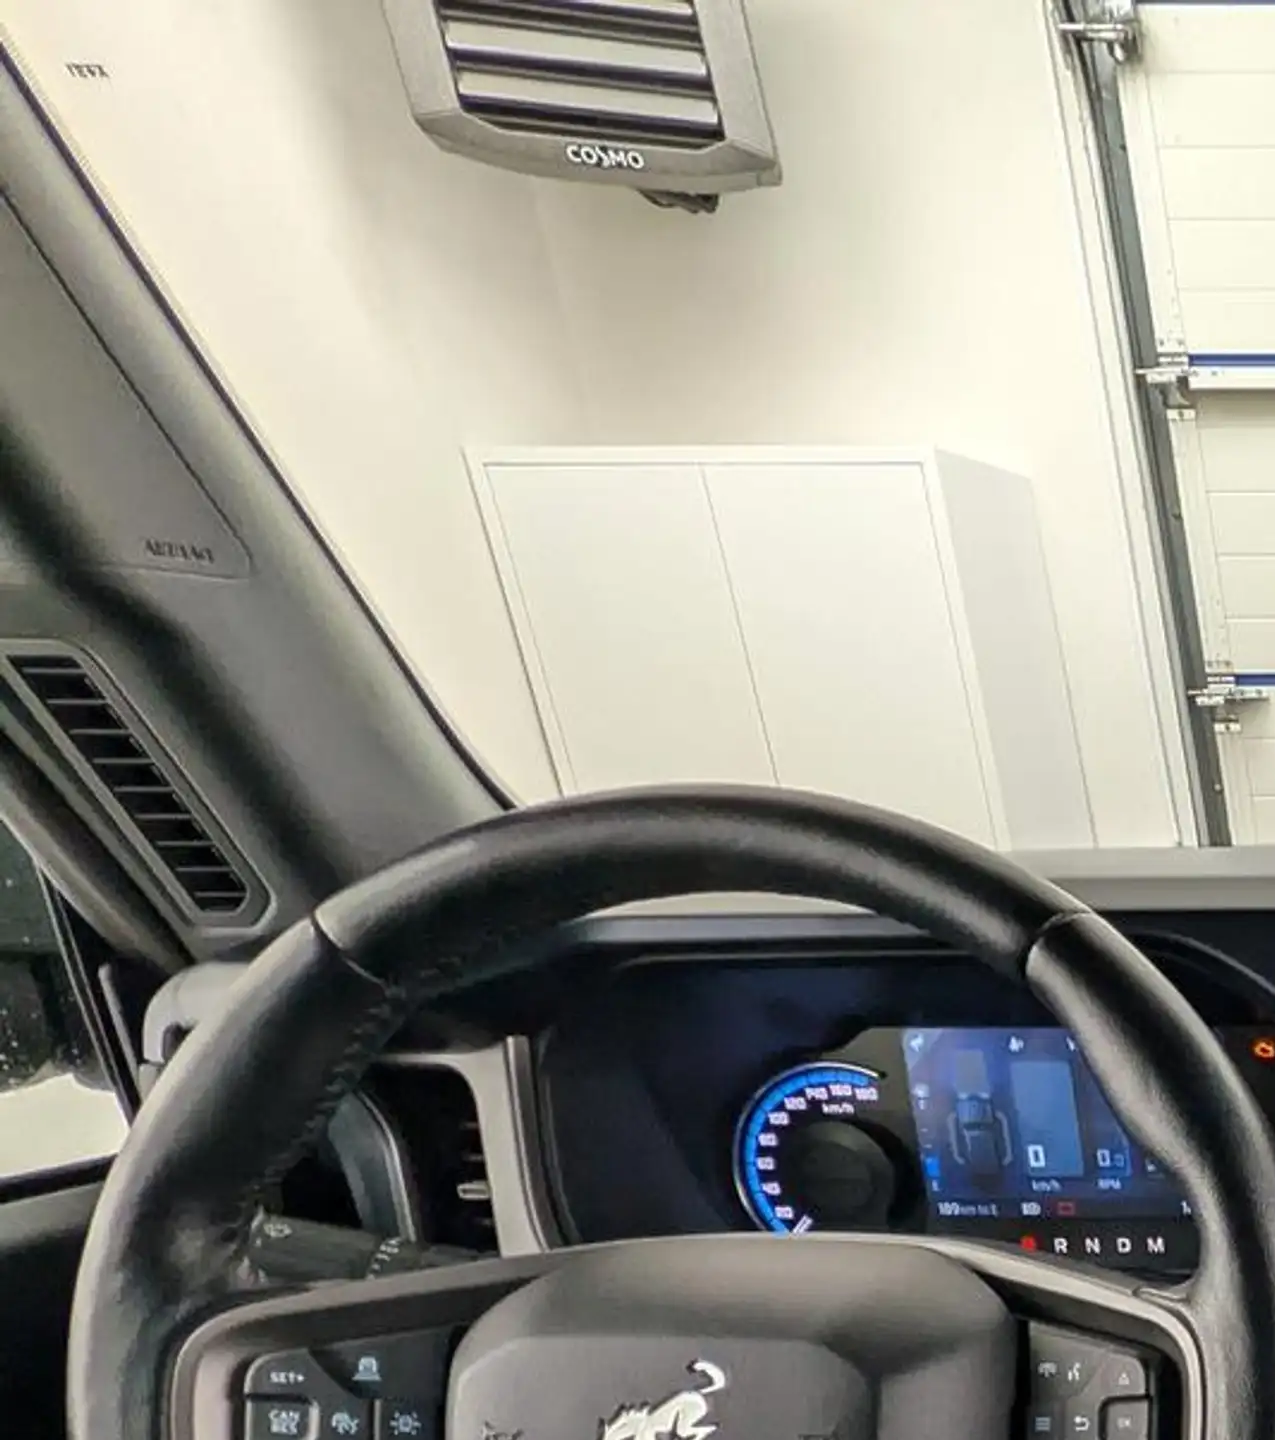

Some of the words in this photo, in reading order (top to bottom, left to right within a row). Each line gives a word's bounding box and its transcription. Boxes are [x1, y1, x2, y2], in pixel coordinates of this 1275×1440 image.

[566, 145, 645, 170] COSMO
[1027, 1144, 1046, 1168] 0
[1054, 1237, 1068, 1253] R
[1085, 1237, 1100, 1253] N
[1116, 1237, 1131, 1252] D
[1147, 1236, 1165, 1252] M
